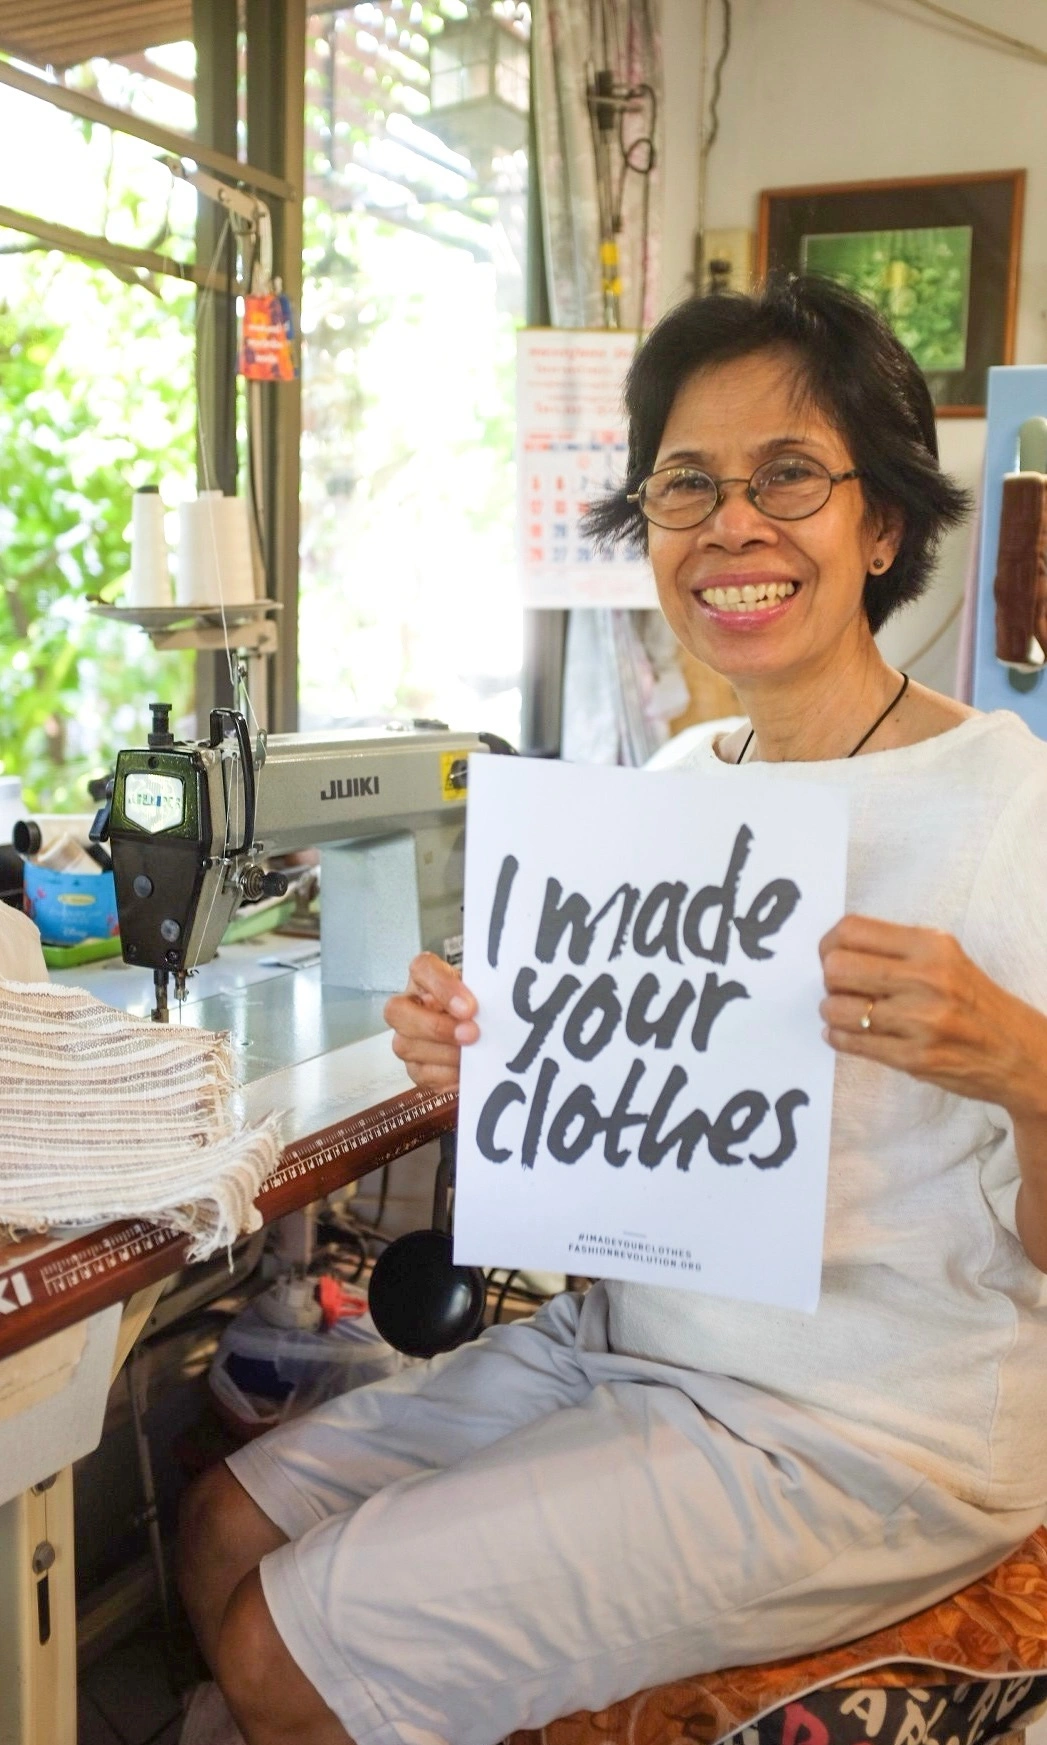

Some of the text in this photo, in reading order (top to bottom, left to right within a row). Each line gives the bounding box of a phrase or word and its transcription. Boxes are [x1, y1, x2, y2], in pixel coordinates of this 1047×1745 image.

[487, 823, 801, 968] I made
[506, 966, 751, 1074] your
[475, 1057, 810, 1173] clothes
[569, 1243, 701, 1271] FASHIONREVOLUTION.ORG
[579, 1233, 692, 1258] #IMADEYOURCLOTHES
